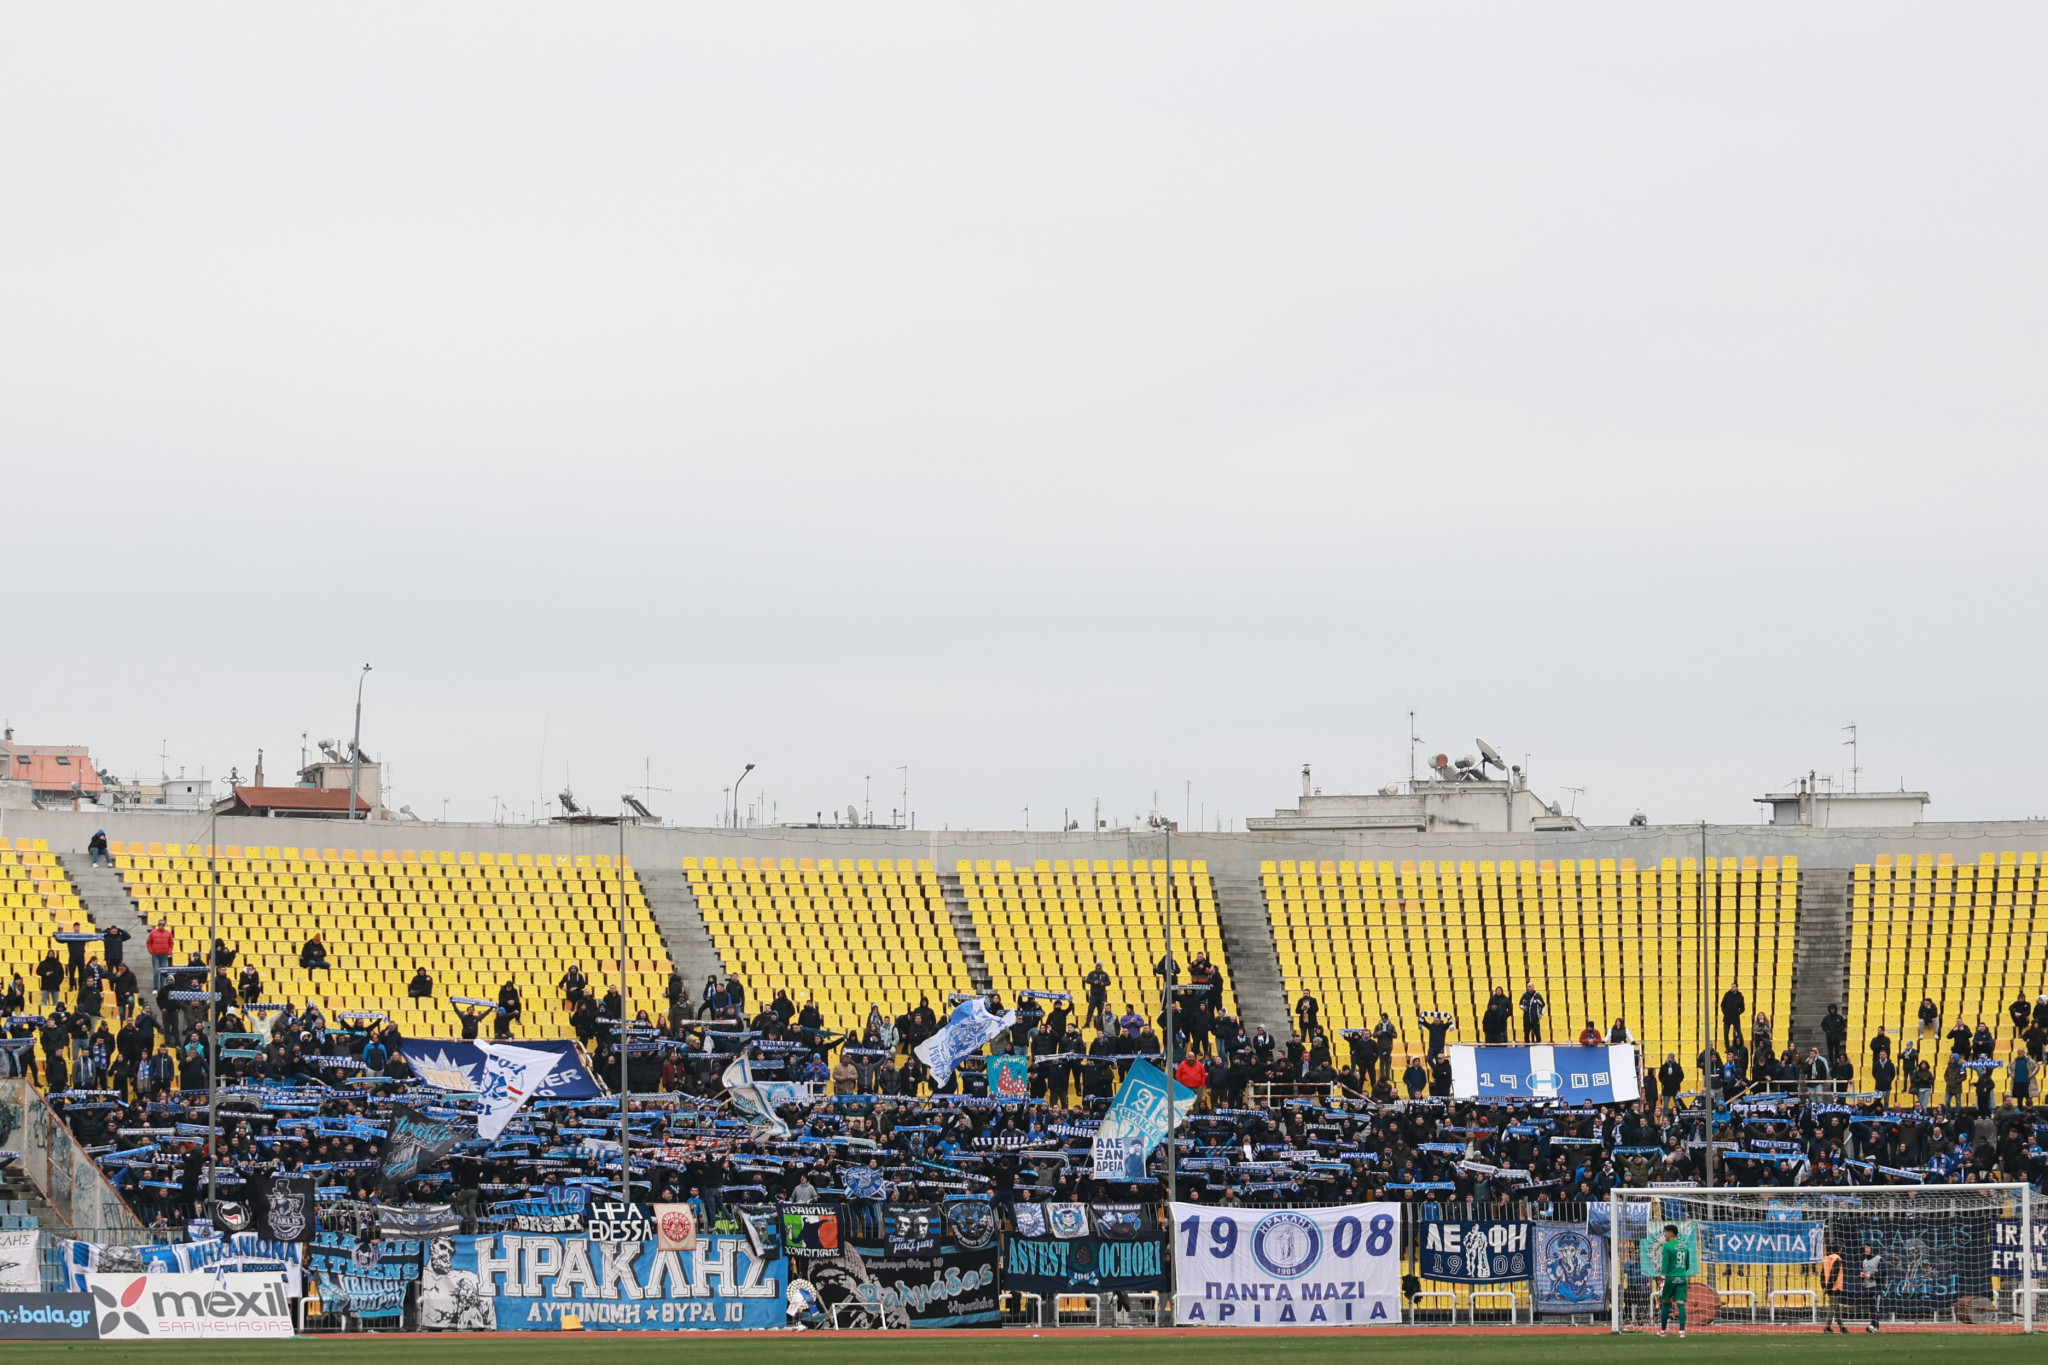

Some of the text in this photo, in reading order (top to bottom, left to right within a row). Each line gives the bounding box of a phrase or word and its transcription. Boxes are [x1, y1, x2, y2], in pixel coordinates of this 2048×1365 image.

[1096, 1138, 1122, 1149] ΑΛΕ
[1096, 1150, 1123, 1160] ΞΑΝ
[1096, 1161, 1123, 1172] ΔΡΕΙΑ
[589, 1220, 653, 1241] EDESSA
[1259, 1213, 1314, 1234] ΗΡΑΚΛΗΣ
[187, 1235, 300, 1271] ΜΗΧΑΝΙΩΝΑ
[309, 1231, 420, 1256] IRALIS
[1715, 1233, 1807, 1252] ΤΟΥΜΠΑ
[475, 1235, 777, 1300] ΗΡΑΚΛΗΣ
[1008, 1238, 1162, 1278] ASVEST OCHORI
[1676, 1251, 1686, 1264] 91
[1073, 1271, 1096, 1280] 1964
[1277, 1267, 1296, 1276] 1908
[152, 1282, 289, 1318] mexil
[1205, 1280, 1365, 1301] ΠΑΝΤΑ ΜΑΖΙ
[527, 1302, 744, 1324] ΑΥΤΟΝΟΜΗ ΘΥΡΑ 10
[159, 1321, 293, 1332] SARIKEHAGIAS
